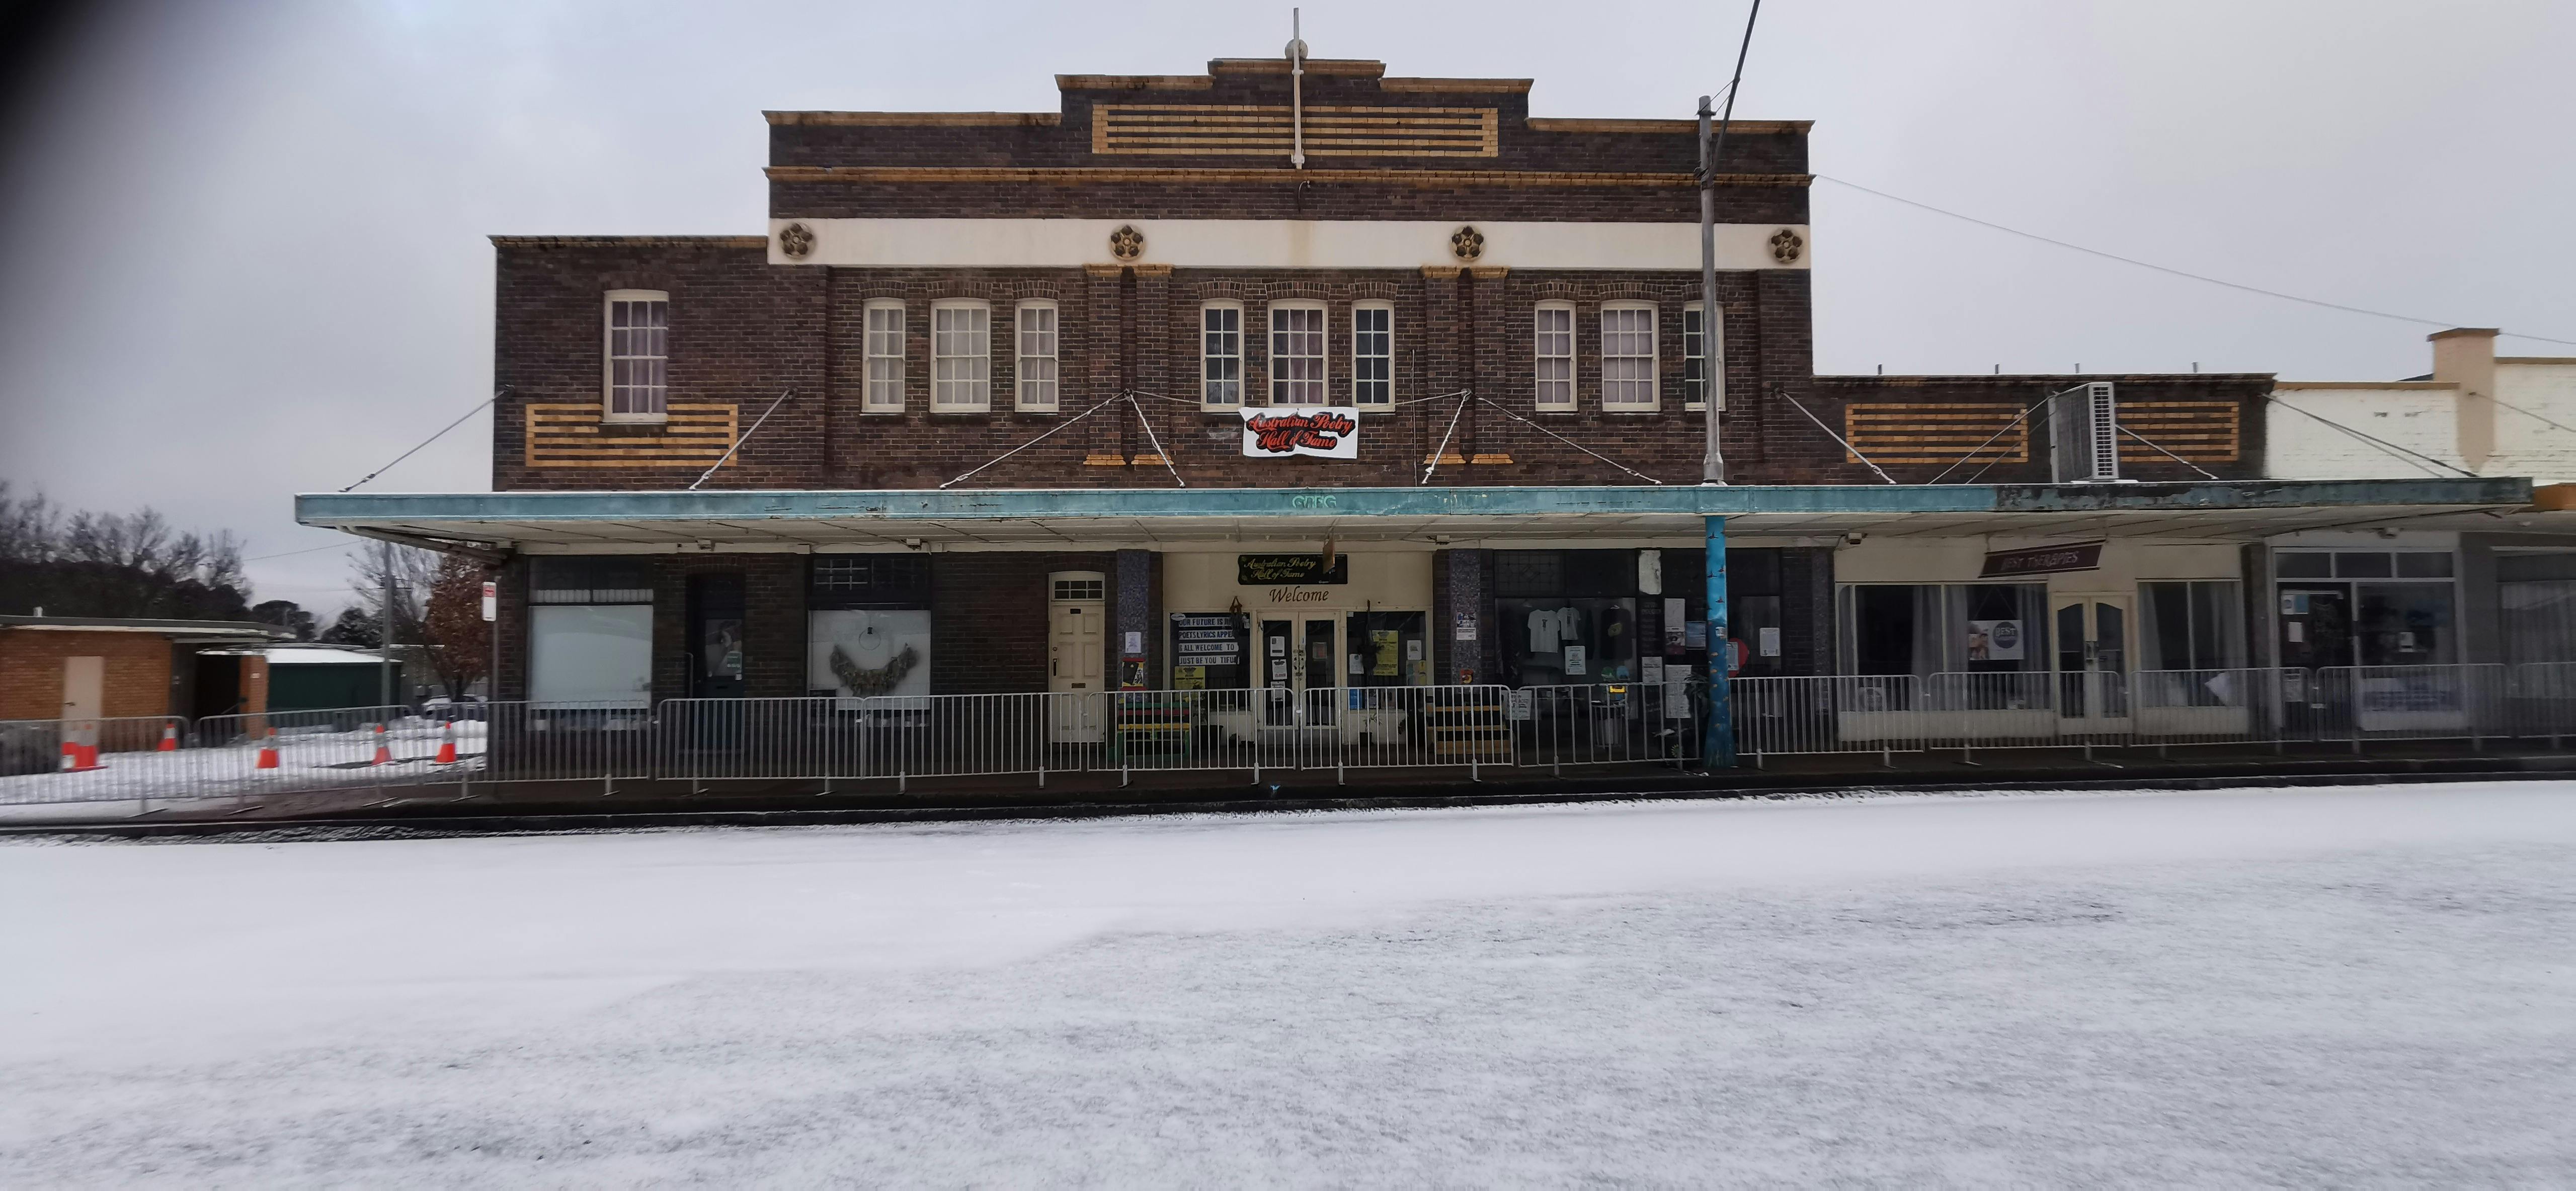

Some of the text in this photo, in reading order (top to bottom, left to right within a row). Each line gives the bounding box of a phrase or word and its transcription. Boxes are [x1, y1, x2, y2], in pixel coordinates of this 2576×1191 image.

[1249, 414, 1353, 435] Australian Poetry
[1258, 430, 1336, 450] Hall of Fame
[1244, 557, 1317, 570] Australian Poetry
[1251, 568, 1305, 580] Hall of Fame
[1269, 586, 1329, 602] Welcome
